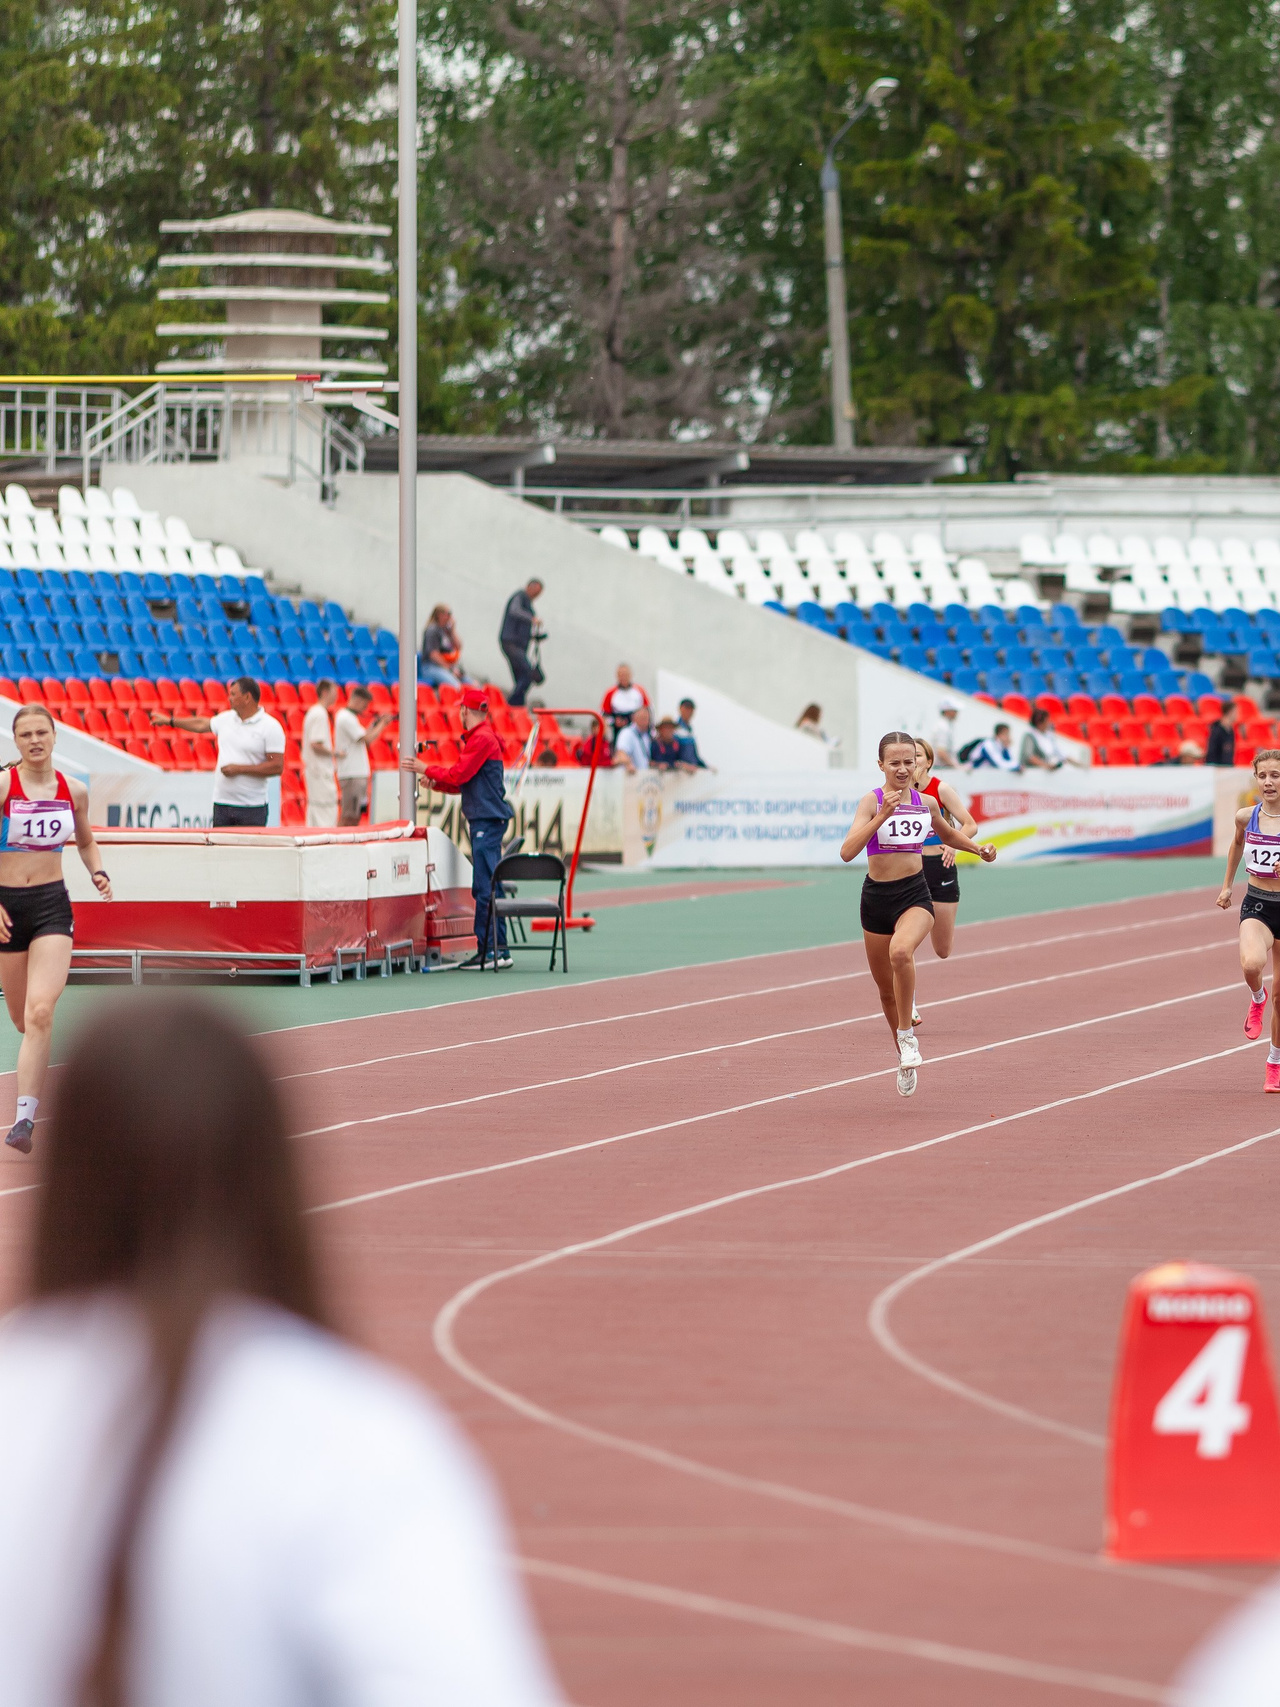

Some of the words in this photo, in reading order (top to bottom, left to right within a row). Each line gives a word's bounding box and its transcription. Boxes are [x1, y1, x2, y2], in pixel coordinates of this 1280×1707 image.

[22, 819, 62, 838] 119
[888, 820, 923, 837] 139
[1153, 1323, 1251, 1460] 4
